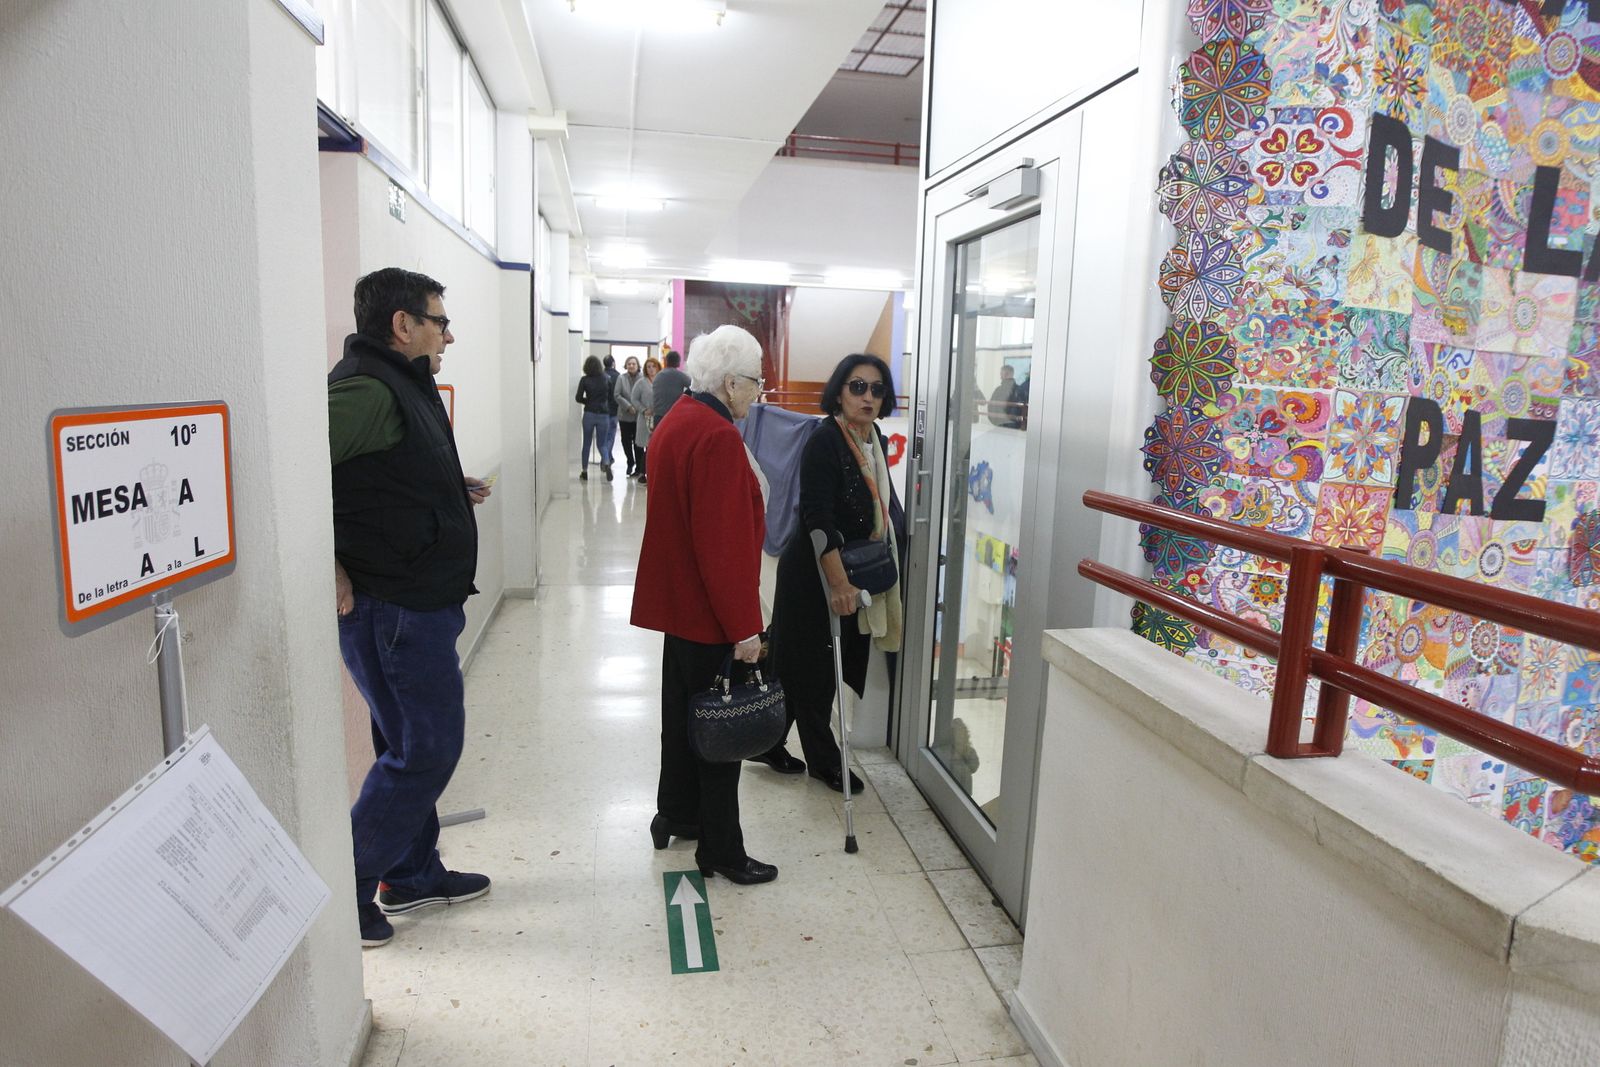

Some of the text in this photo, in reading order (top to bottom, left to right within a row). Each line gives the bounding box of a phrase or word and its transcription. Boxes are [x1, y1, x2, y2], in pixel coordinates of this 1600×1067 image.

[1363, 112, 1600, 282] DE L
[66, 423, 197, 452] SECCIÓN 10ª
[1394, 397, 1557, 522] PAZ
[72, 478, 195, 525] MESA A
[78, 536, 205, 604] De la letra A a la L
